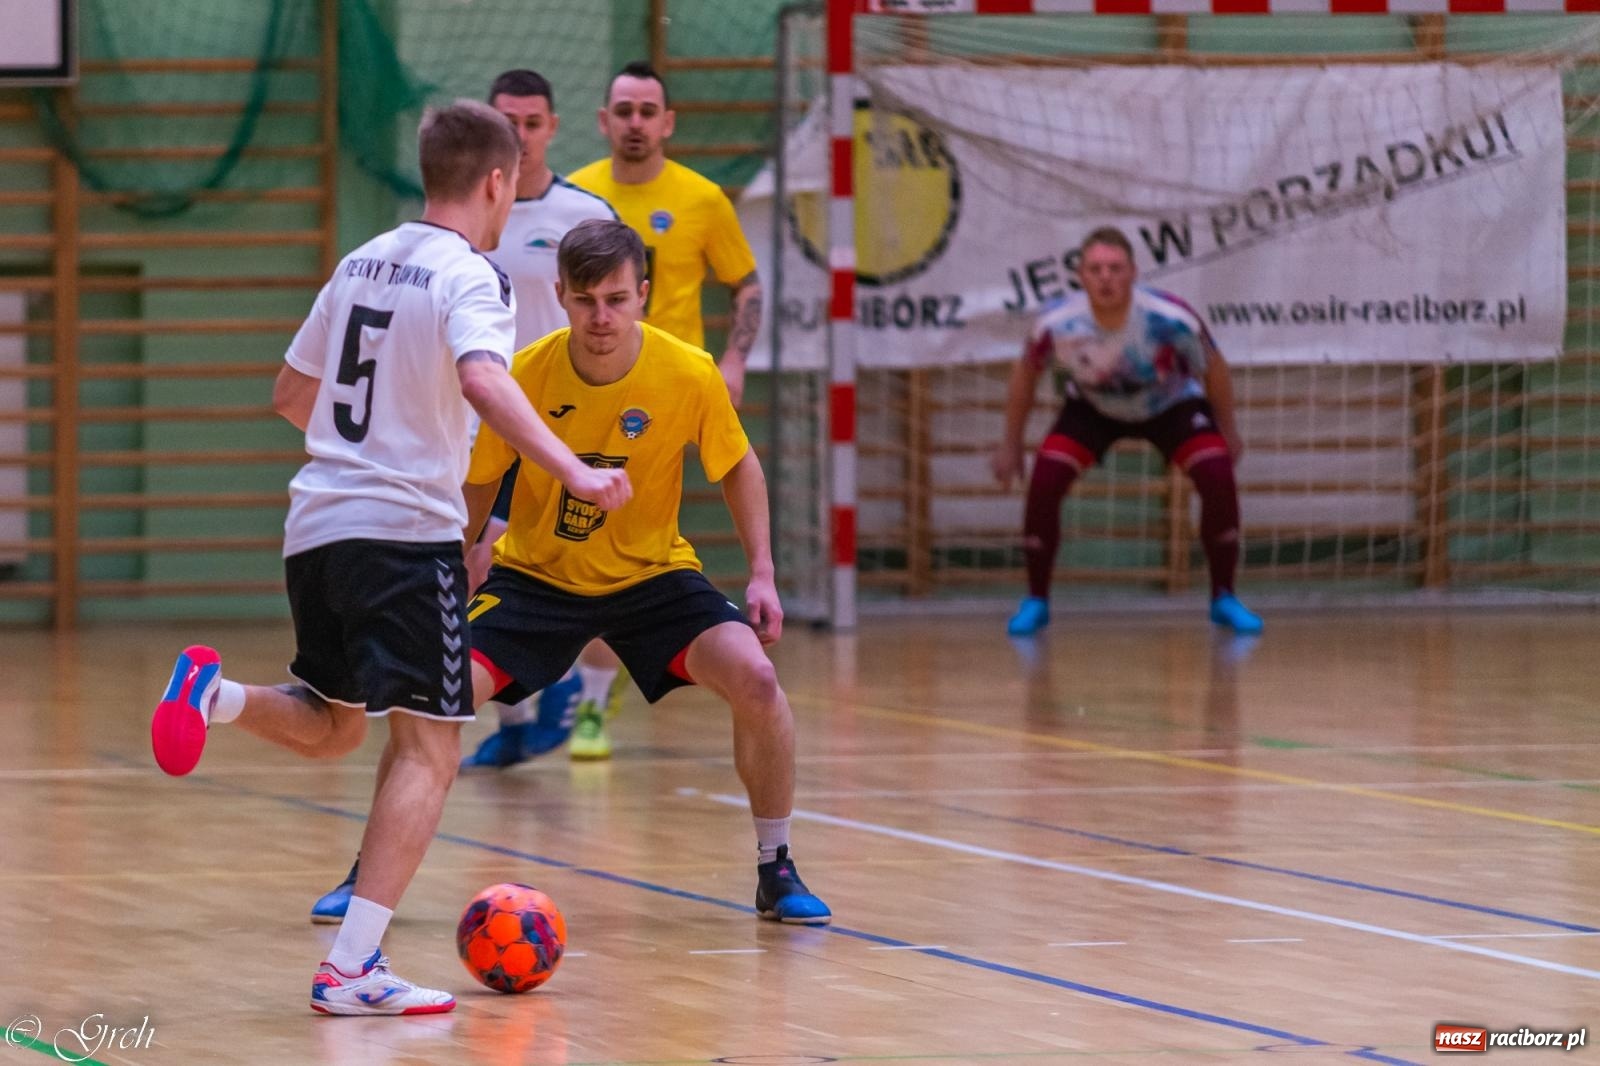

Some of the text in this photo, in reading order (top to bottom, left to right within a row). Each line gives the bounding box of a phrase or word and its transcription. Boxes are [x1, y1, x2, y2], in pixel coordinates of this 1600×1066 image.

[1002, 246, 1085, 313] JES
[1138, 212, 1193, 266] W
[1207, 294, 1527, 330] www.osir-raciborz.pl
[333, 303, 395, 443] 5
